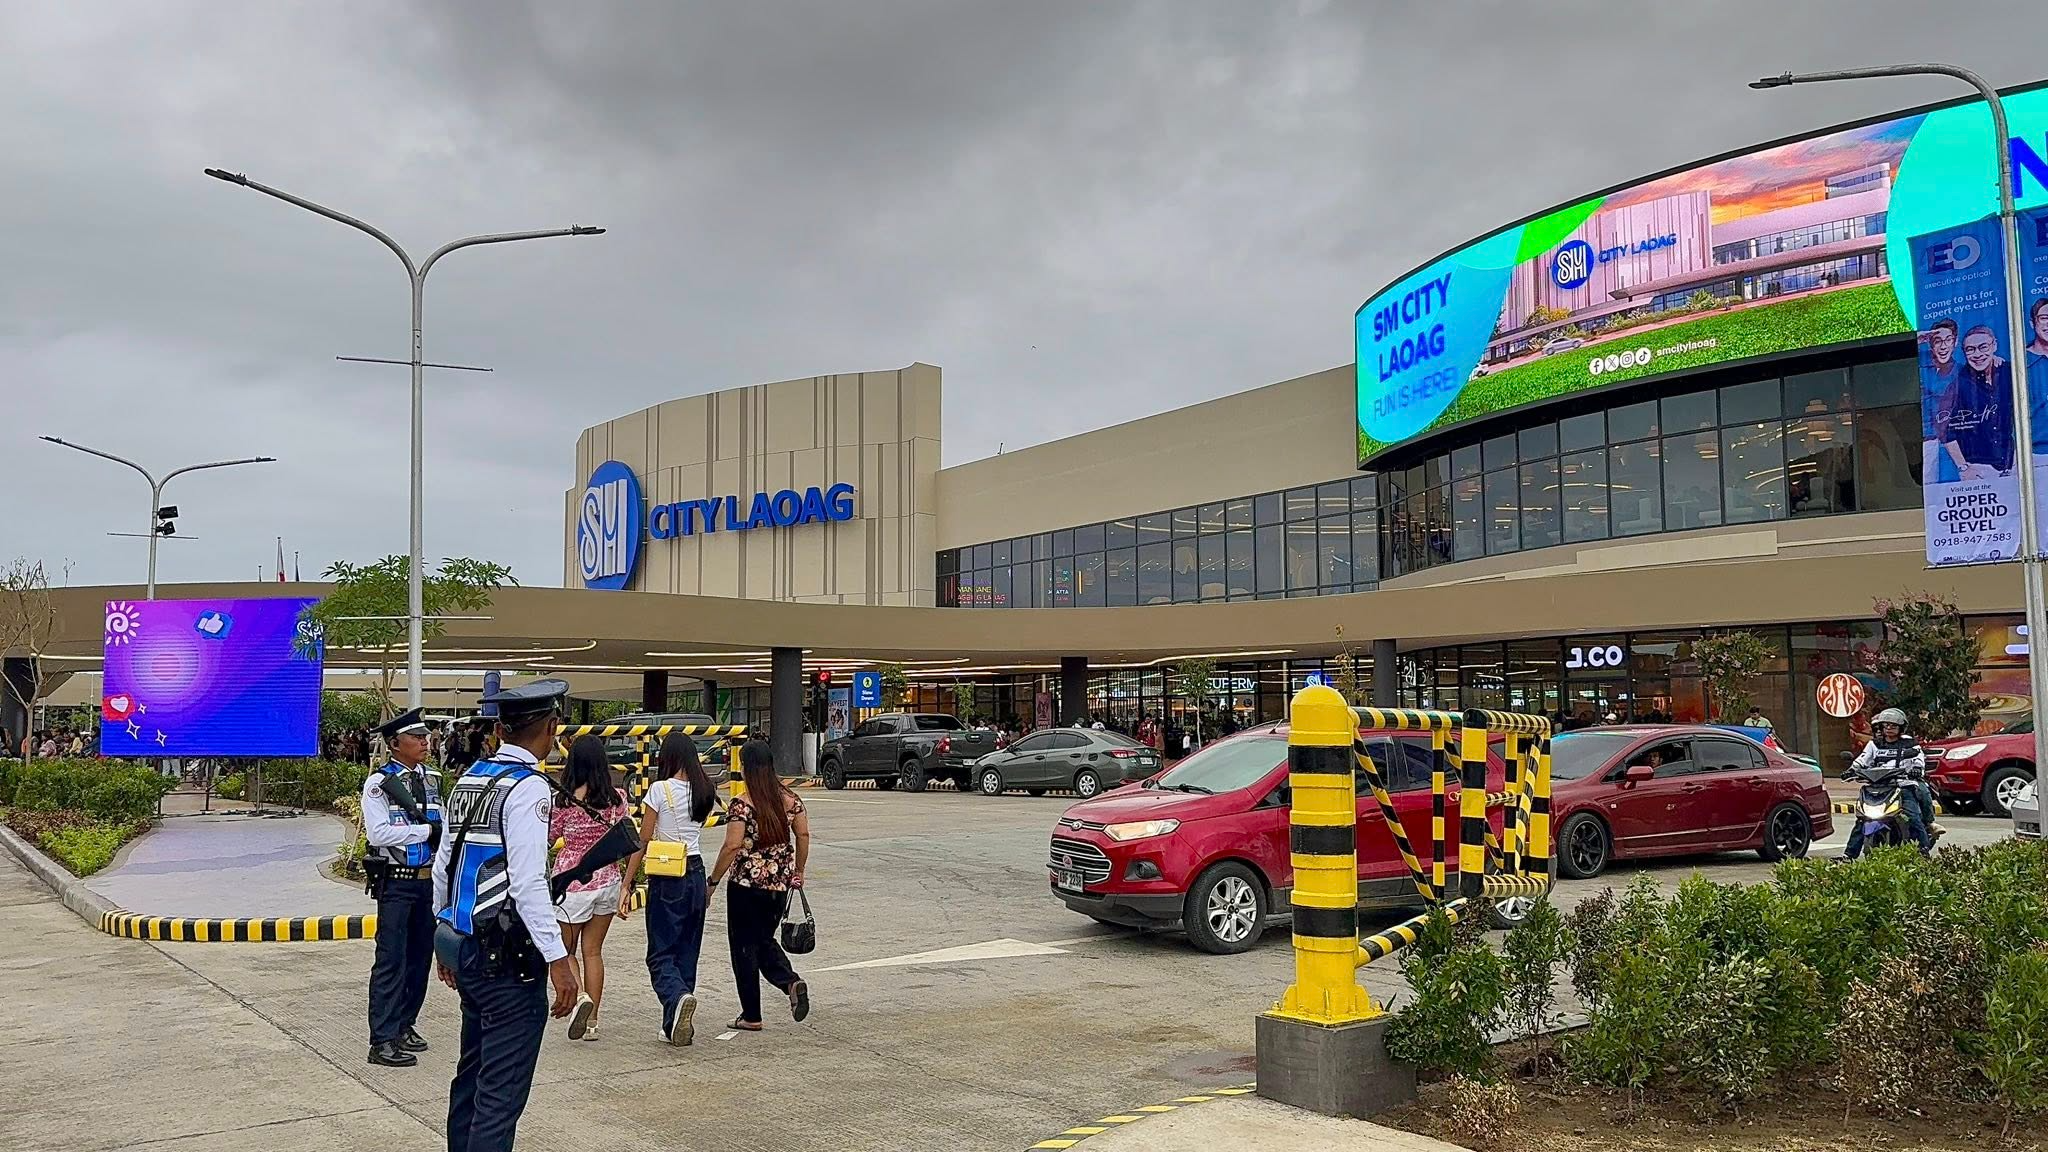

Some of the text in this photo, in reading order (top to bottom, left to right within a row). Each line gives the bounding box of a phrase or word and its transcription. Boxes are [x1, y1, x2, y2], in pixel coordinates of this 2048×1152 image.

[1557, 233, 1677, 285] SM CITY LAOAG
[1926, 235, 1981, 275] EO
[1924, 269, 1991, 290] executive optical
[1373, 272, 1452, 343] SM CITY
[1923, 297, 1999, 321] expert eye care!
[1925, 289, 1994, 311] Come to us for
[1379, 323, 1445, 383] LAOAG
[1656, 337, 1717, 358] smcitylaoag
[1374, 392, 1396, 423] FUN
[1950, 486, 1964, 494] Visit
[1981, 483, 1992, 491] the
[1945, 492, 1999, 509] UPPER
[1937, 505, 2008, 523] GROUND
[579, 478, 855, 581] SM CITY LAOAG
[1950, 519, 1997, 535] LEVEL
[1933, 532, 2013, 548] 0918-947-7583
[1566, 645, 1623, 669] J.CO
